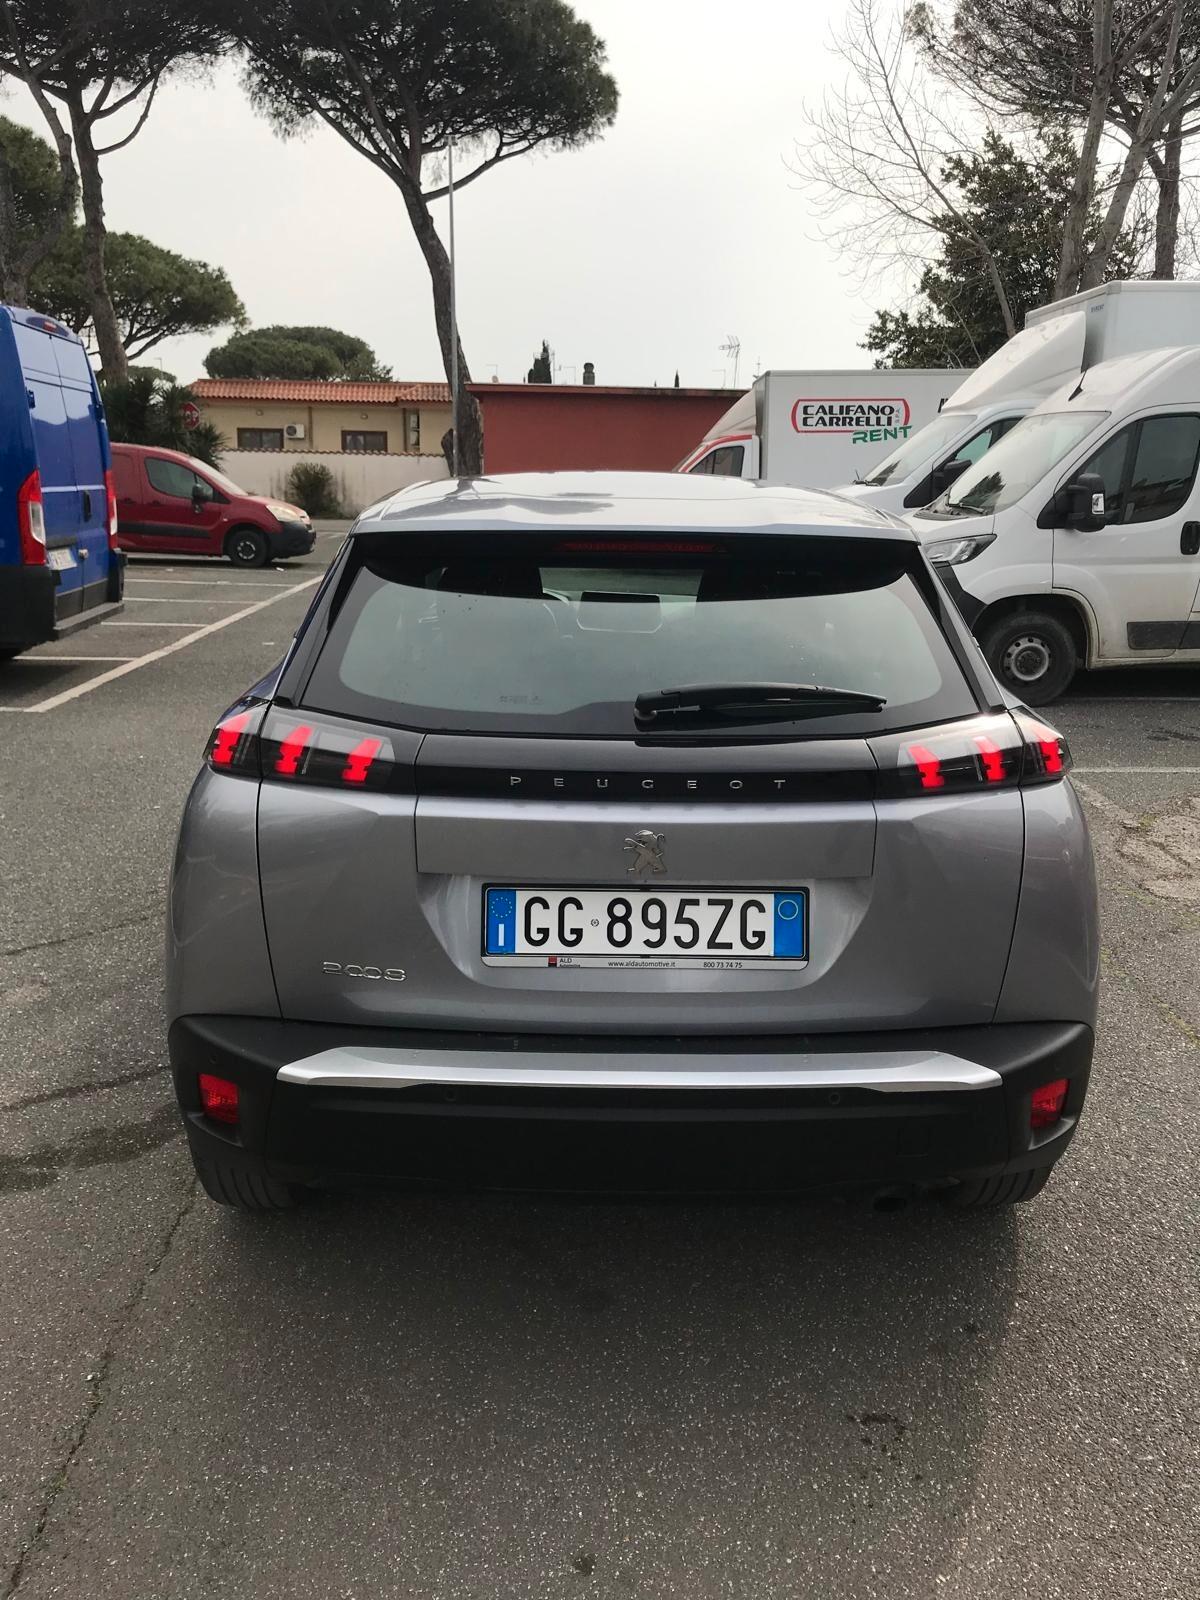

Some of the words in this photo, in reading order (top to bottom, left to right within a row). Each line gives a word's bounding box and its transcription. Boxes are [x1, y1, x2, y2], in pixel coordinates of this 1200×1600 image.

[802, 404, 895, 416] CALIFANO
[802, 416, 893, 427] CARRELLI
[852, 425, 913, 444] RENT
[510, 776, 786, 789] PEUGEOT
[524, 896, 584, 948] GG
[606, 897, 766, 950] 895ZG
[608, 960, 676, 968] www.aldautomotive.it
[322, 961, 407, 981] 2008
